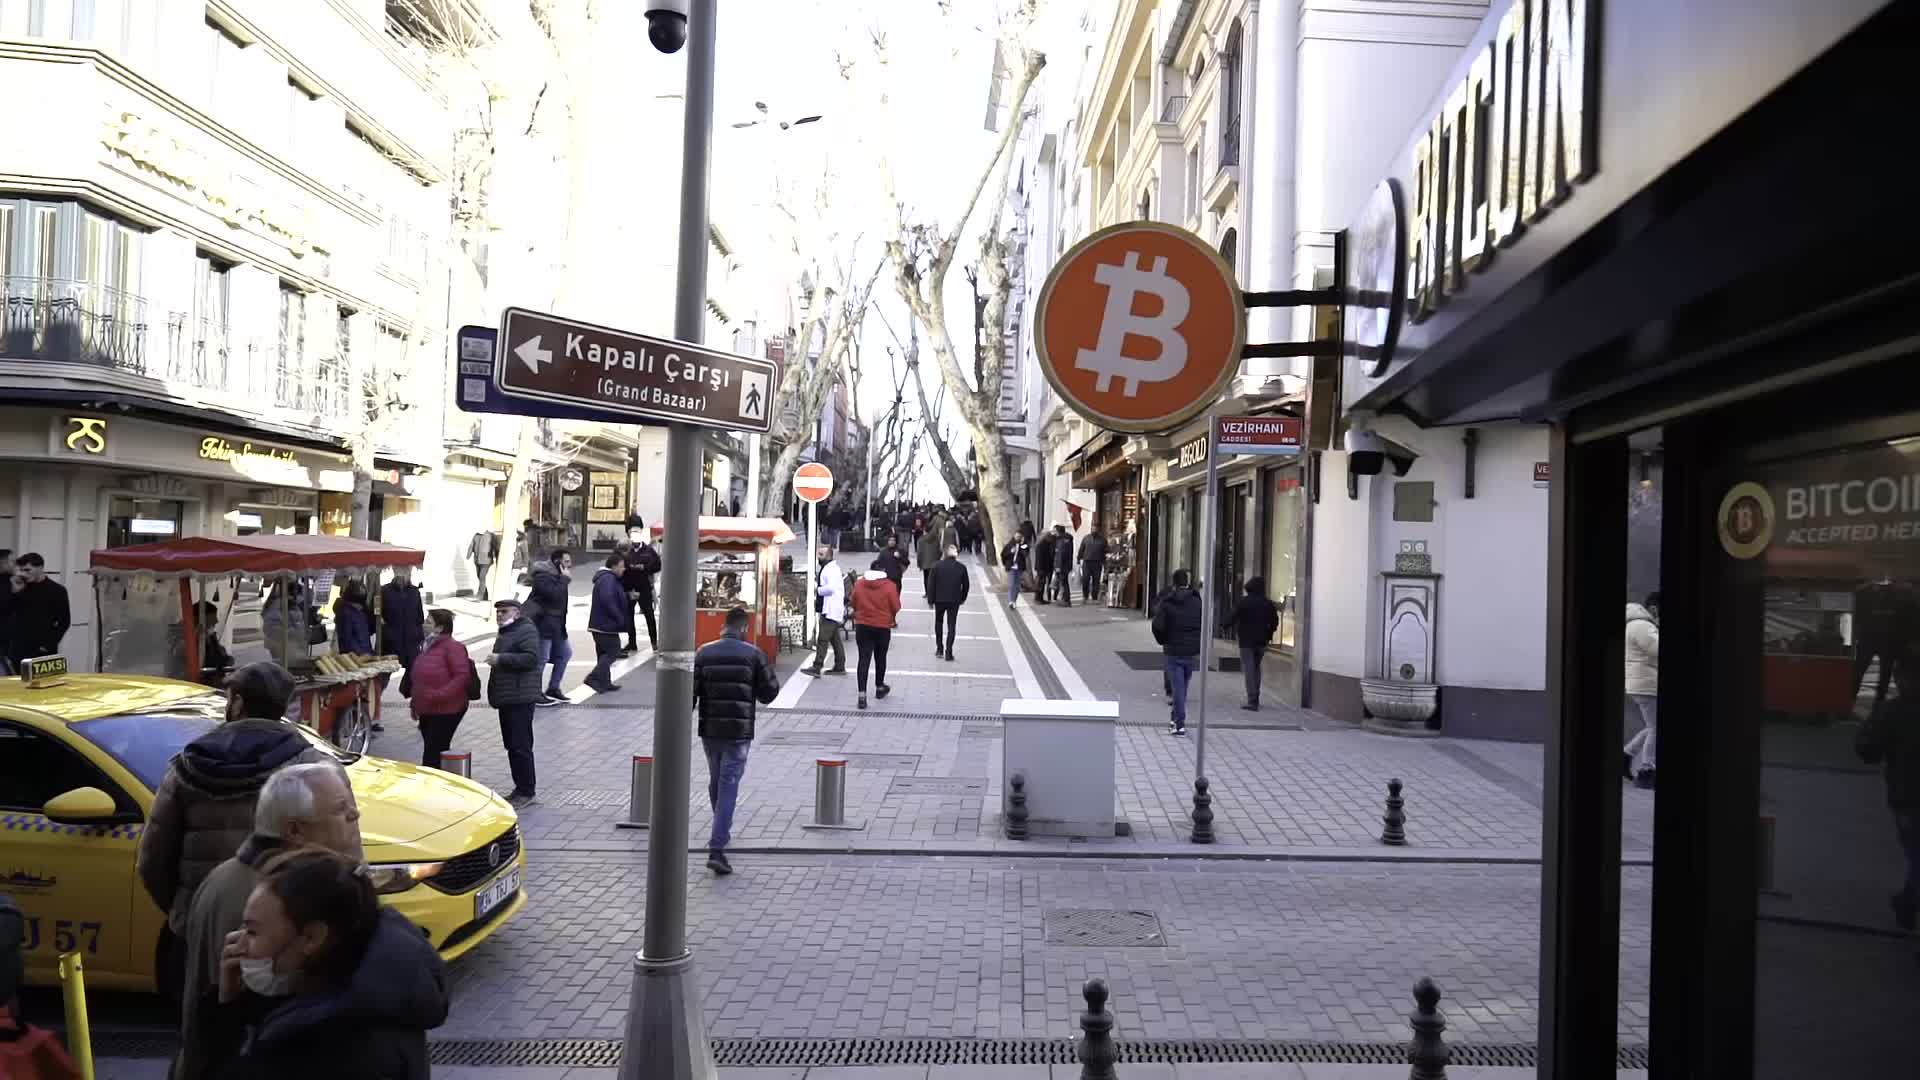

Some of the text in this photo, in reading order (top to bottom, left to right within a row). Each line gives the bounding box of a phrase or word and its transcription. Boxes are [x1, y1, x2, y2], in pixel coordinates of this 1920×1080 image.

[565, 332, 729, 391] Kapalı Çarşı
[597, 377, 706, 411] (Grand Bazaar)
[1222, 422, 1284, 434] VEZİRHANI
[1786, 523, 1878, 544] ACCEPTED
[55, 920, 103, 953] 57
